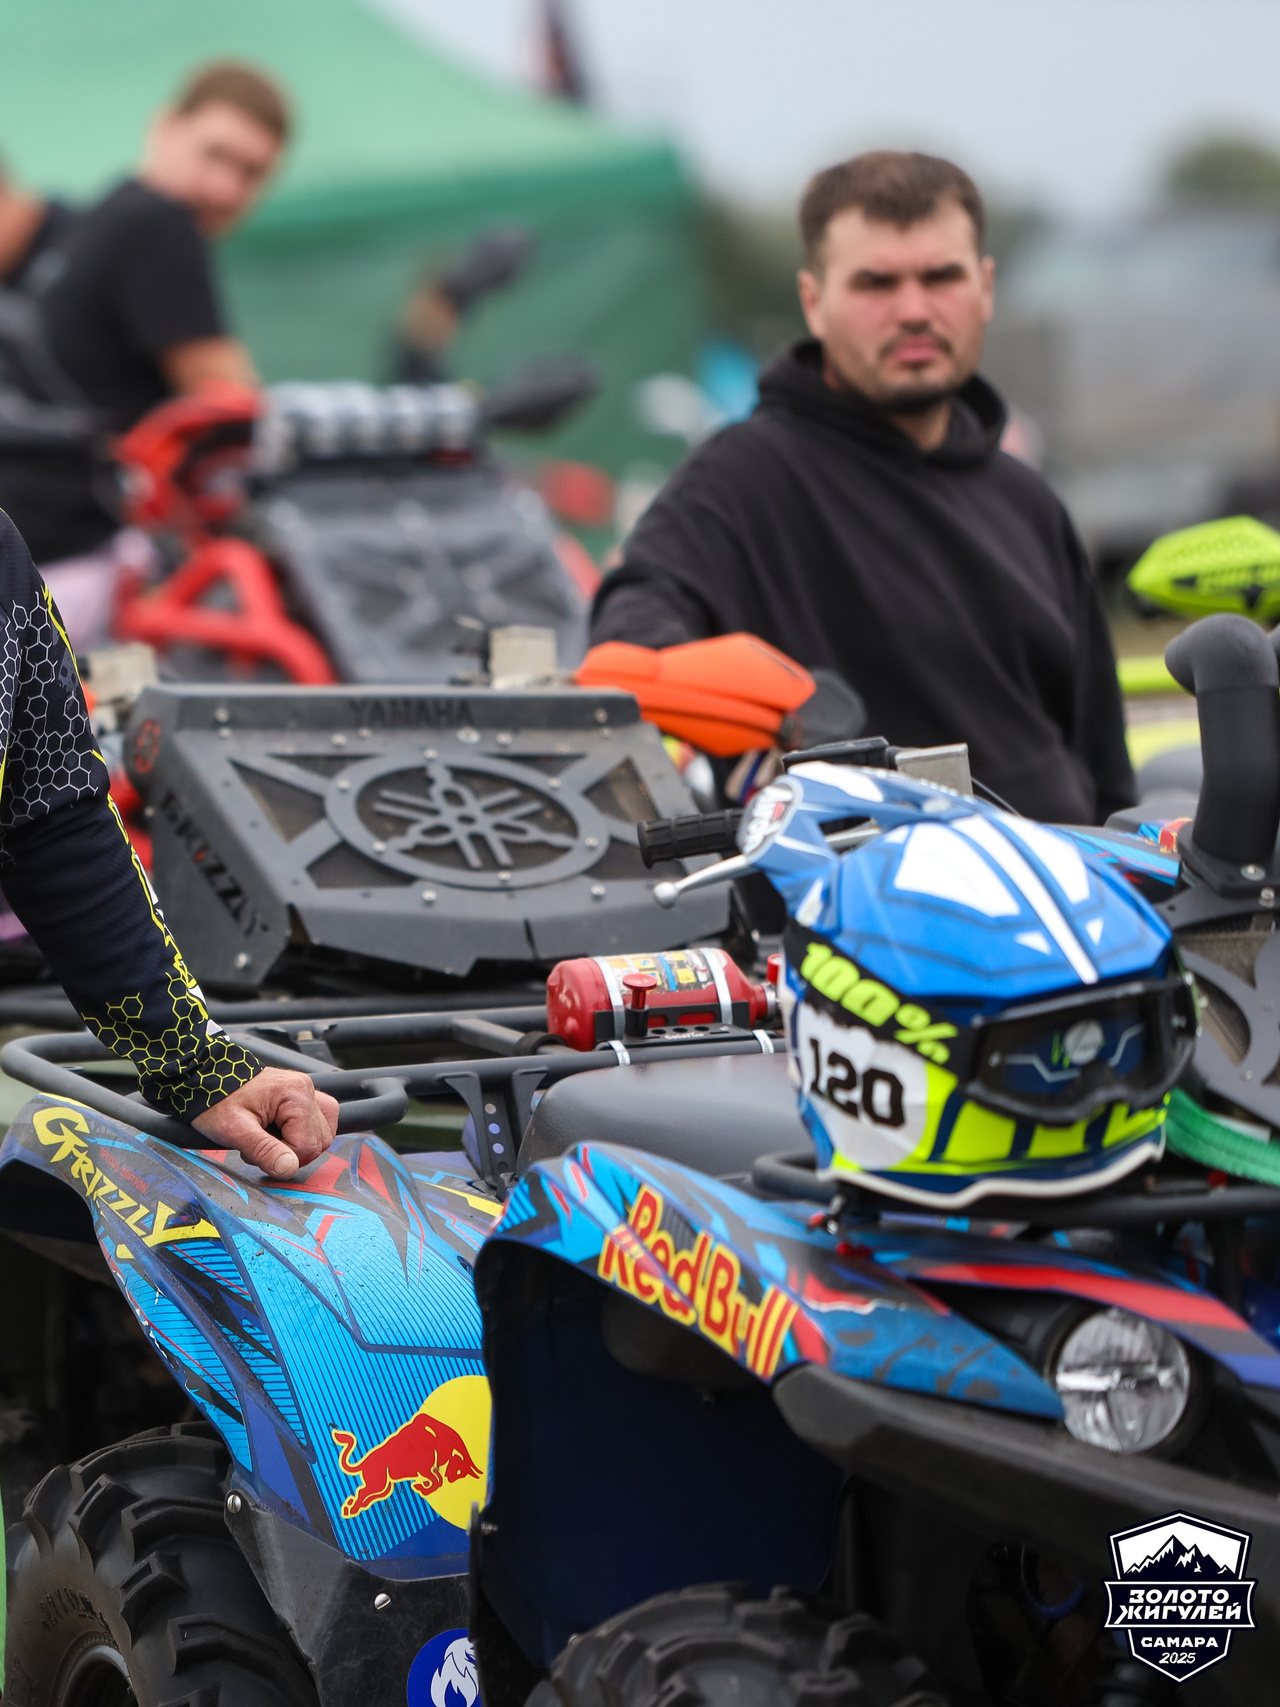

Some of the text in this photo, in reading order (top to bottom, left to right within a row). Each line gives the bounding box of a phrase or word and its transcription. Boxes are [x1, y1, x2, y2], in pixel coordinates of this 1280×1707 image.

[347, 697, 475, 729] YAMAHA
[799, 942, 958, 1064] 100%
[808, 1037, 906, 1129] 120
[32, 1106, 221, 1249] GRIZZLY
